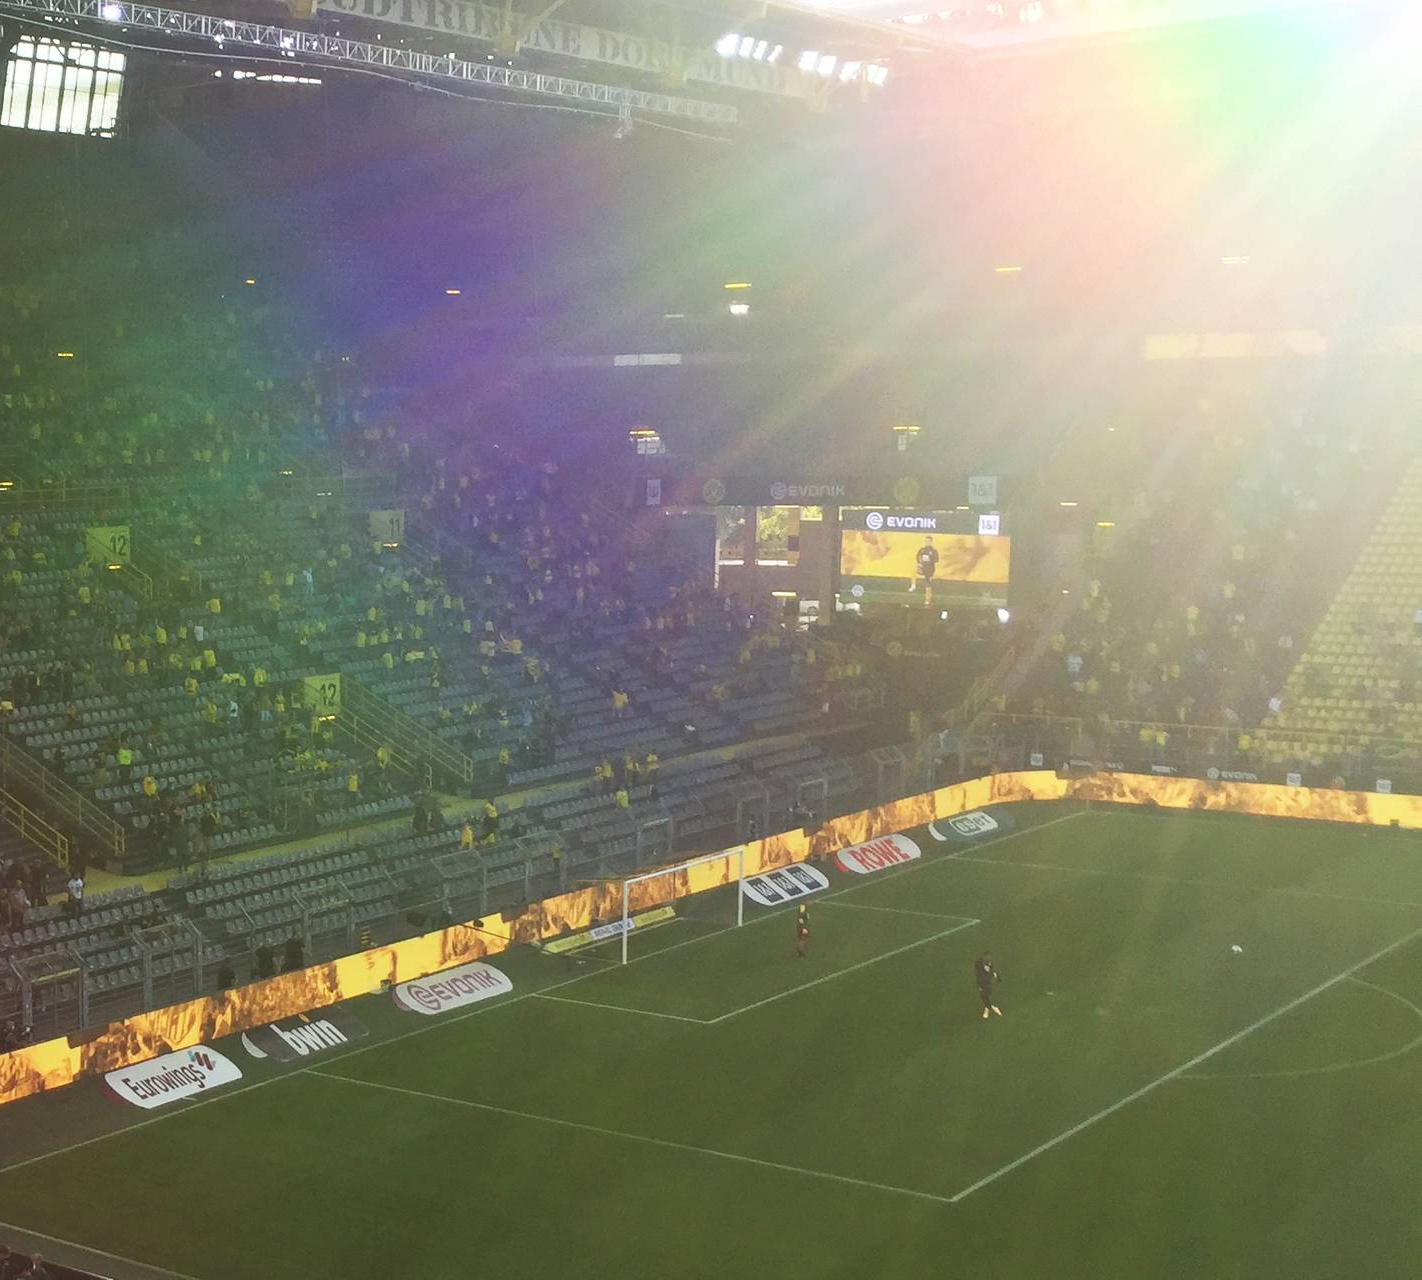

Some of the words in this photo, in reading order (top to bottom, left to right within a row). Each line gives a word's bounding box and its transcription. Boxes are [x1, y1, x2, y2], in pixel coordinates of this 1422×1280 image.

[788, 484, 845, 497] EVONIK
[887, 515, 937, 529] EVONIK
[110, 534, 127, 556] 12
[321, 683, 337, 706] 12
[848, 838, 911, 871] ROWE
[429, 968, 502, 1001] EVONIK
[270, 1014, 349, 1056] bwin
[122, 1063, 207, 1100] Eurowings
